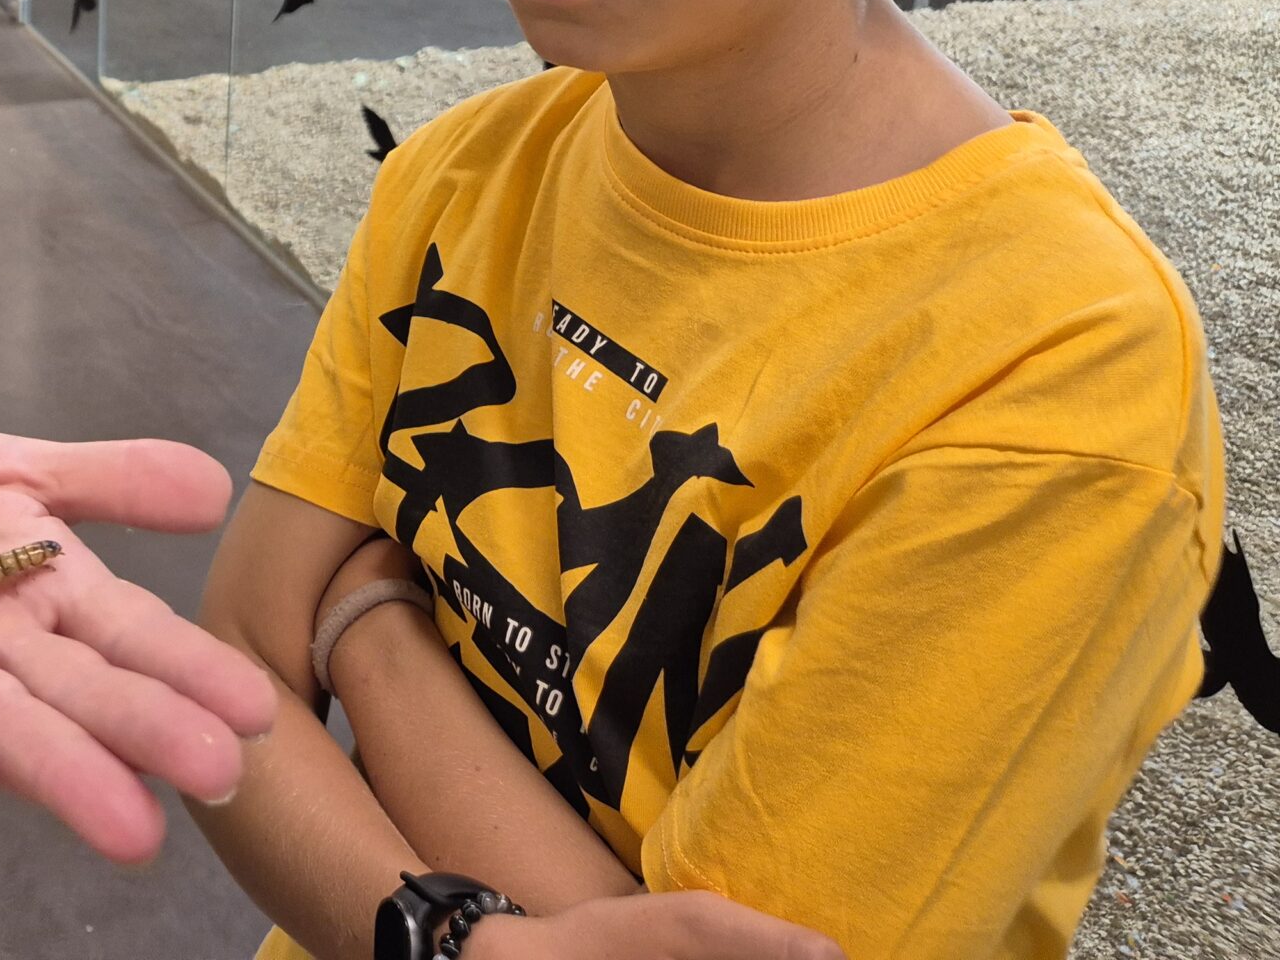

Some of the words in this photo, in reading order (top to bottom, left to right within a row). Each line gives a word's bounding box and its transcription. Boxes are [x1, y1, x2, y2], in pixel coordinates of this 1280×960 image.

[553, 346, 603, 392] THE
[629, 361, 658, 394] TO
[452, 579, 494, 630] BORN
[505, 617, 533, 653] TO
[535, 678, 564, 717] TO
